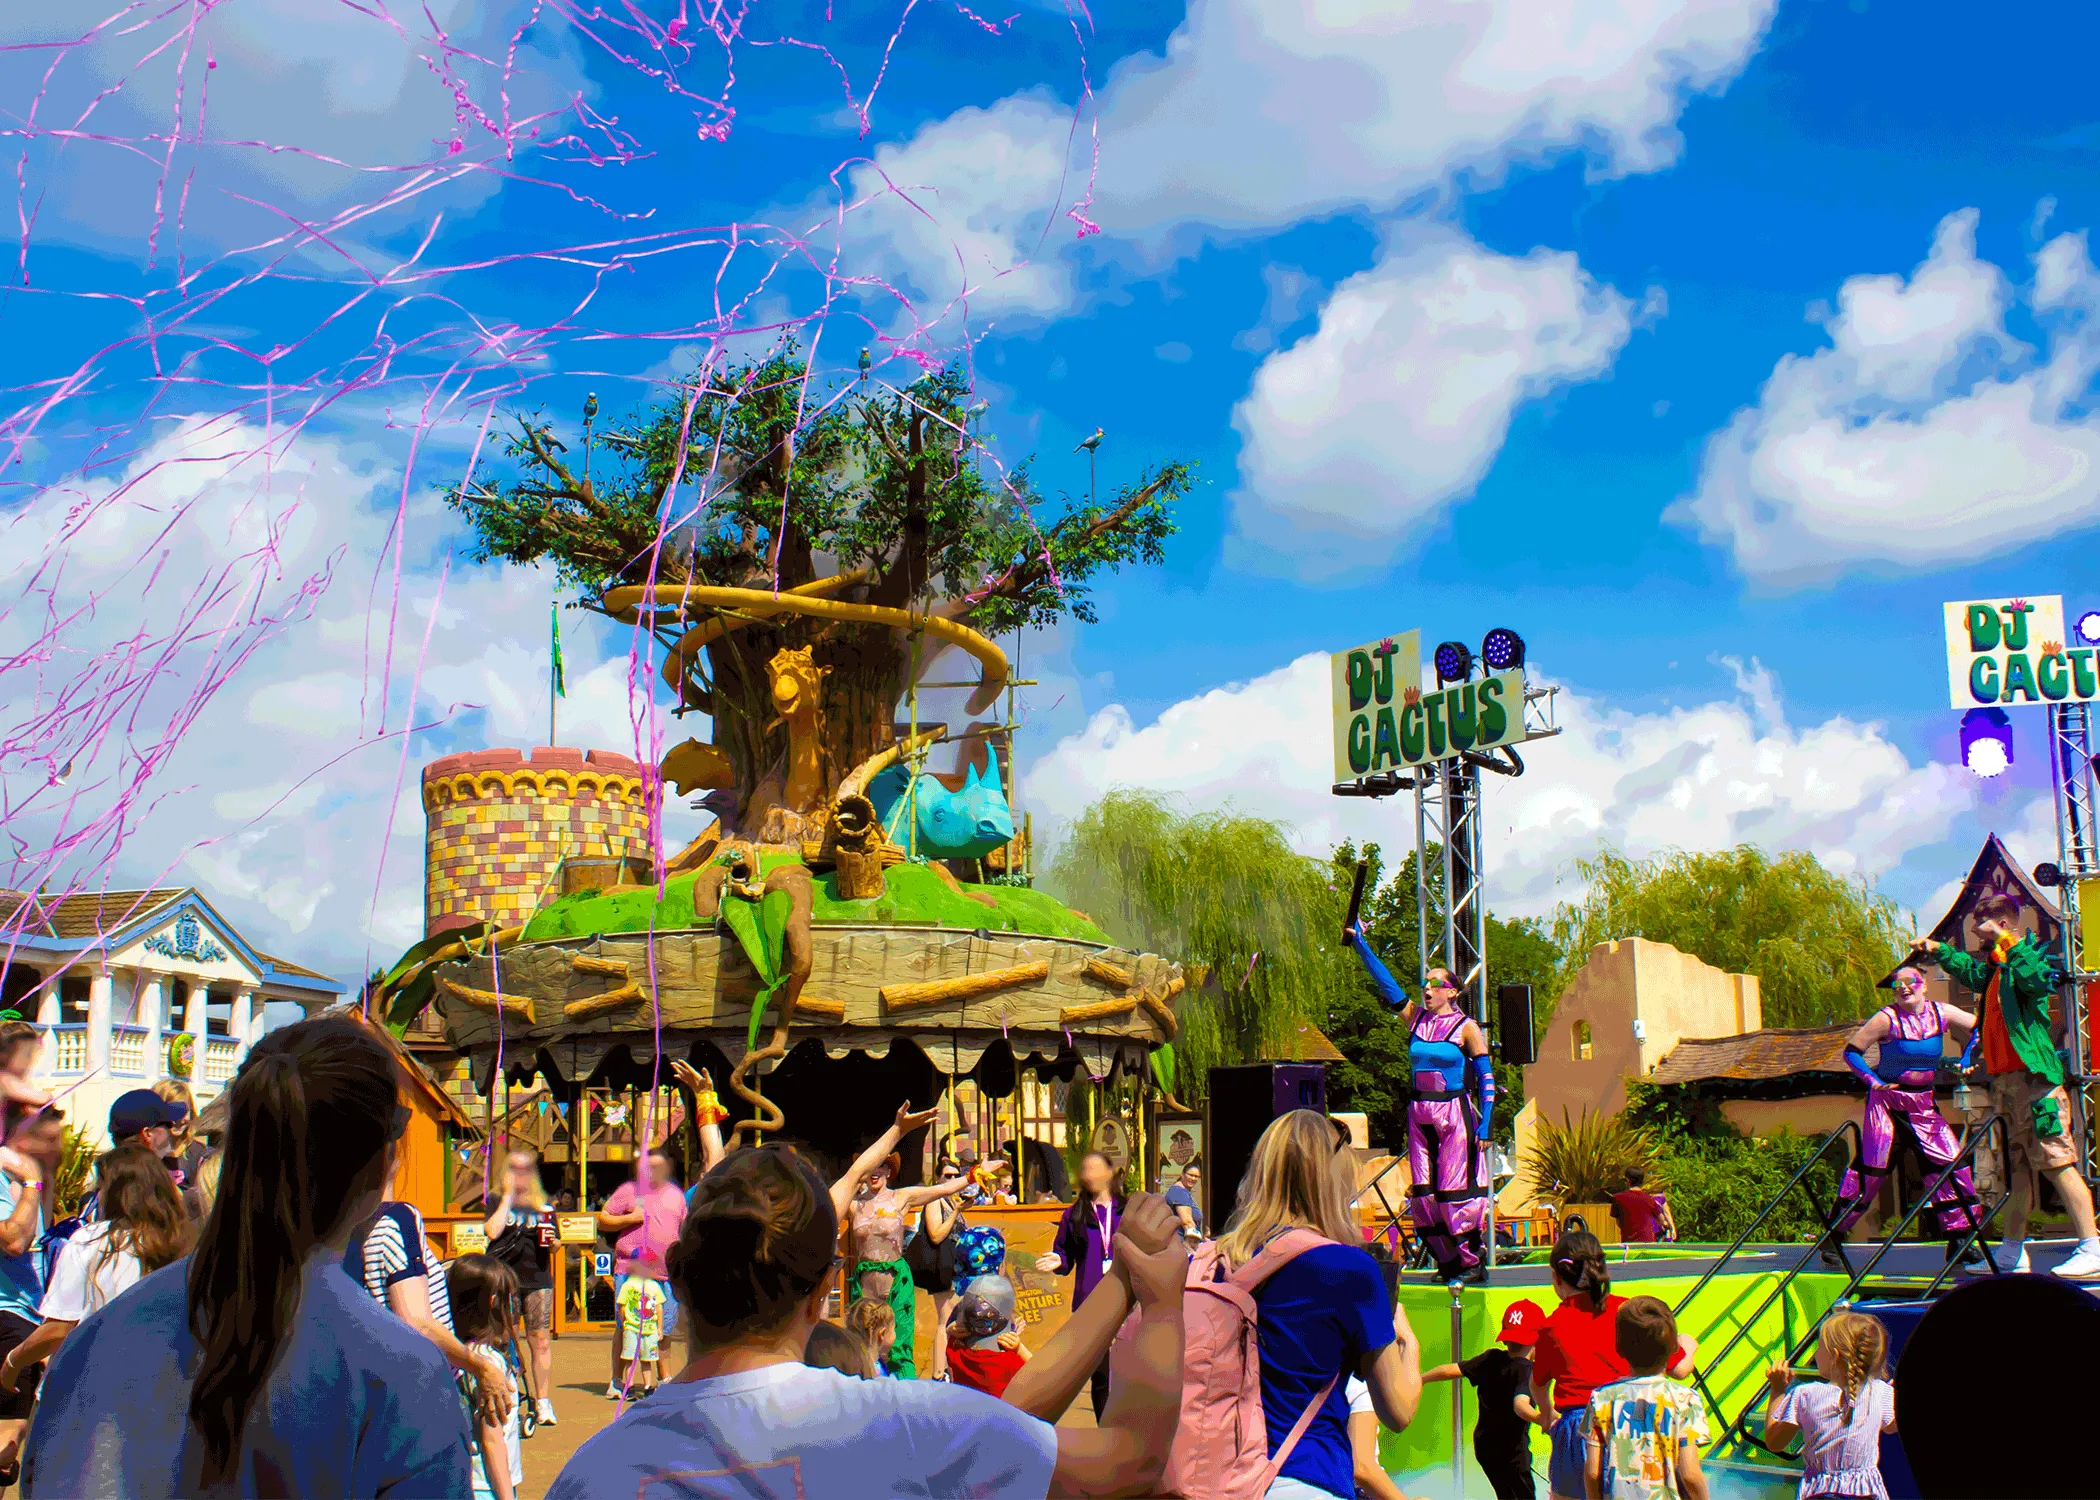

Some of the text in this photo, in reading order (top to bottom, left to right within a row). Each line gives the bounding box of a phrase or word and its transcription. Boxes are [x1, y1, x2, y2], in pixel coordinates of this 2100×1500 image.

[1968, 603, 2035, 652] DJ
[1347, 643, 1400, 711] DJ
[1347, 678, 1508, 774] CACTUS
[1017, 1293, 1063, 1311] NTURE
